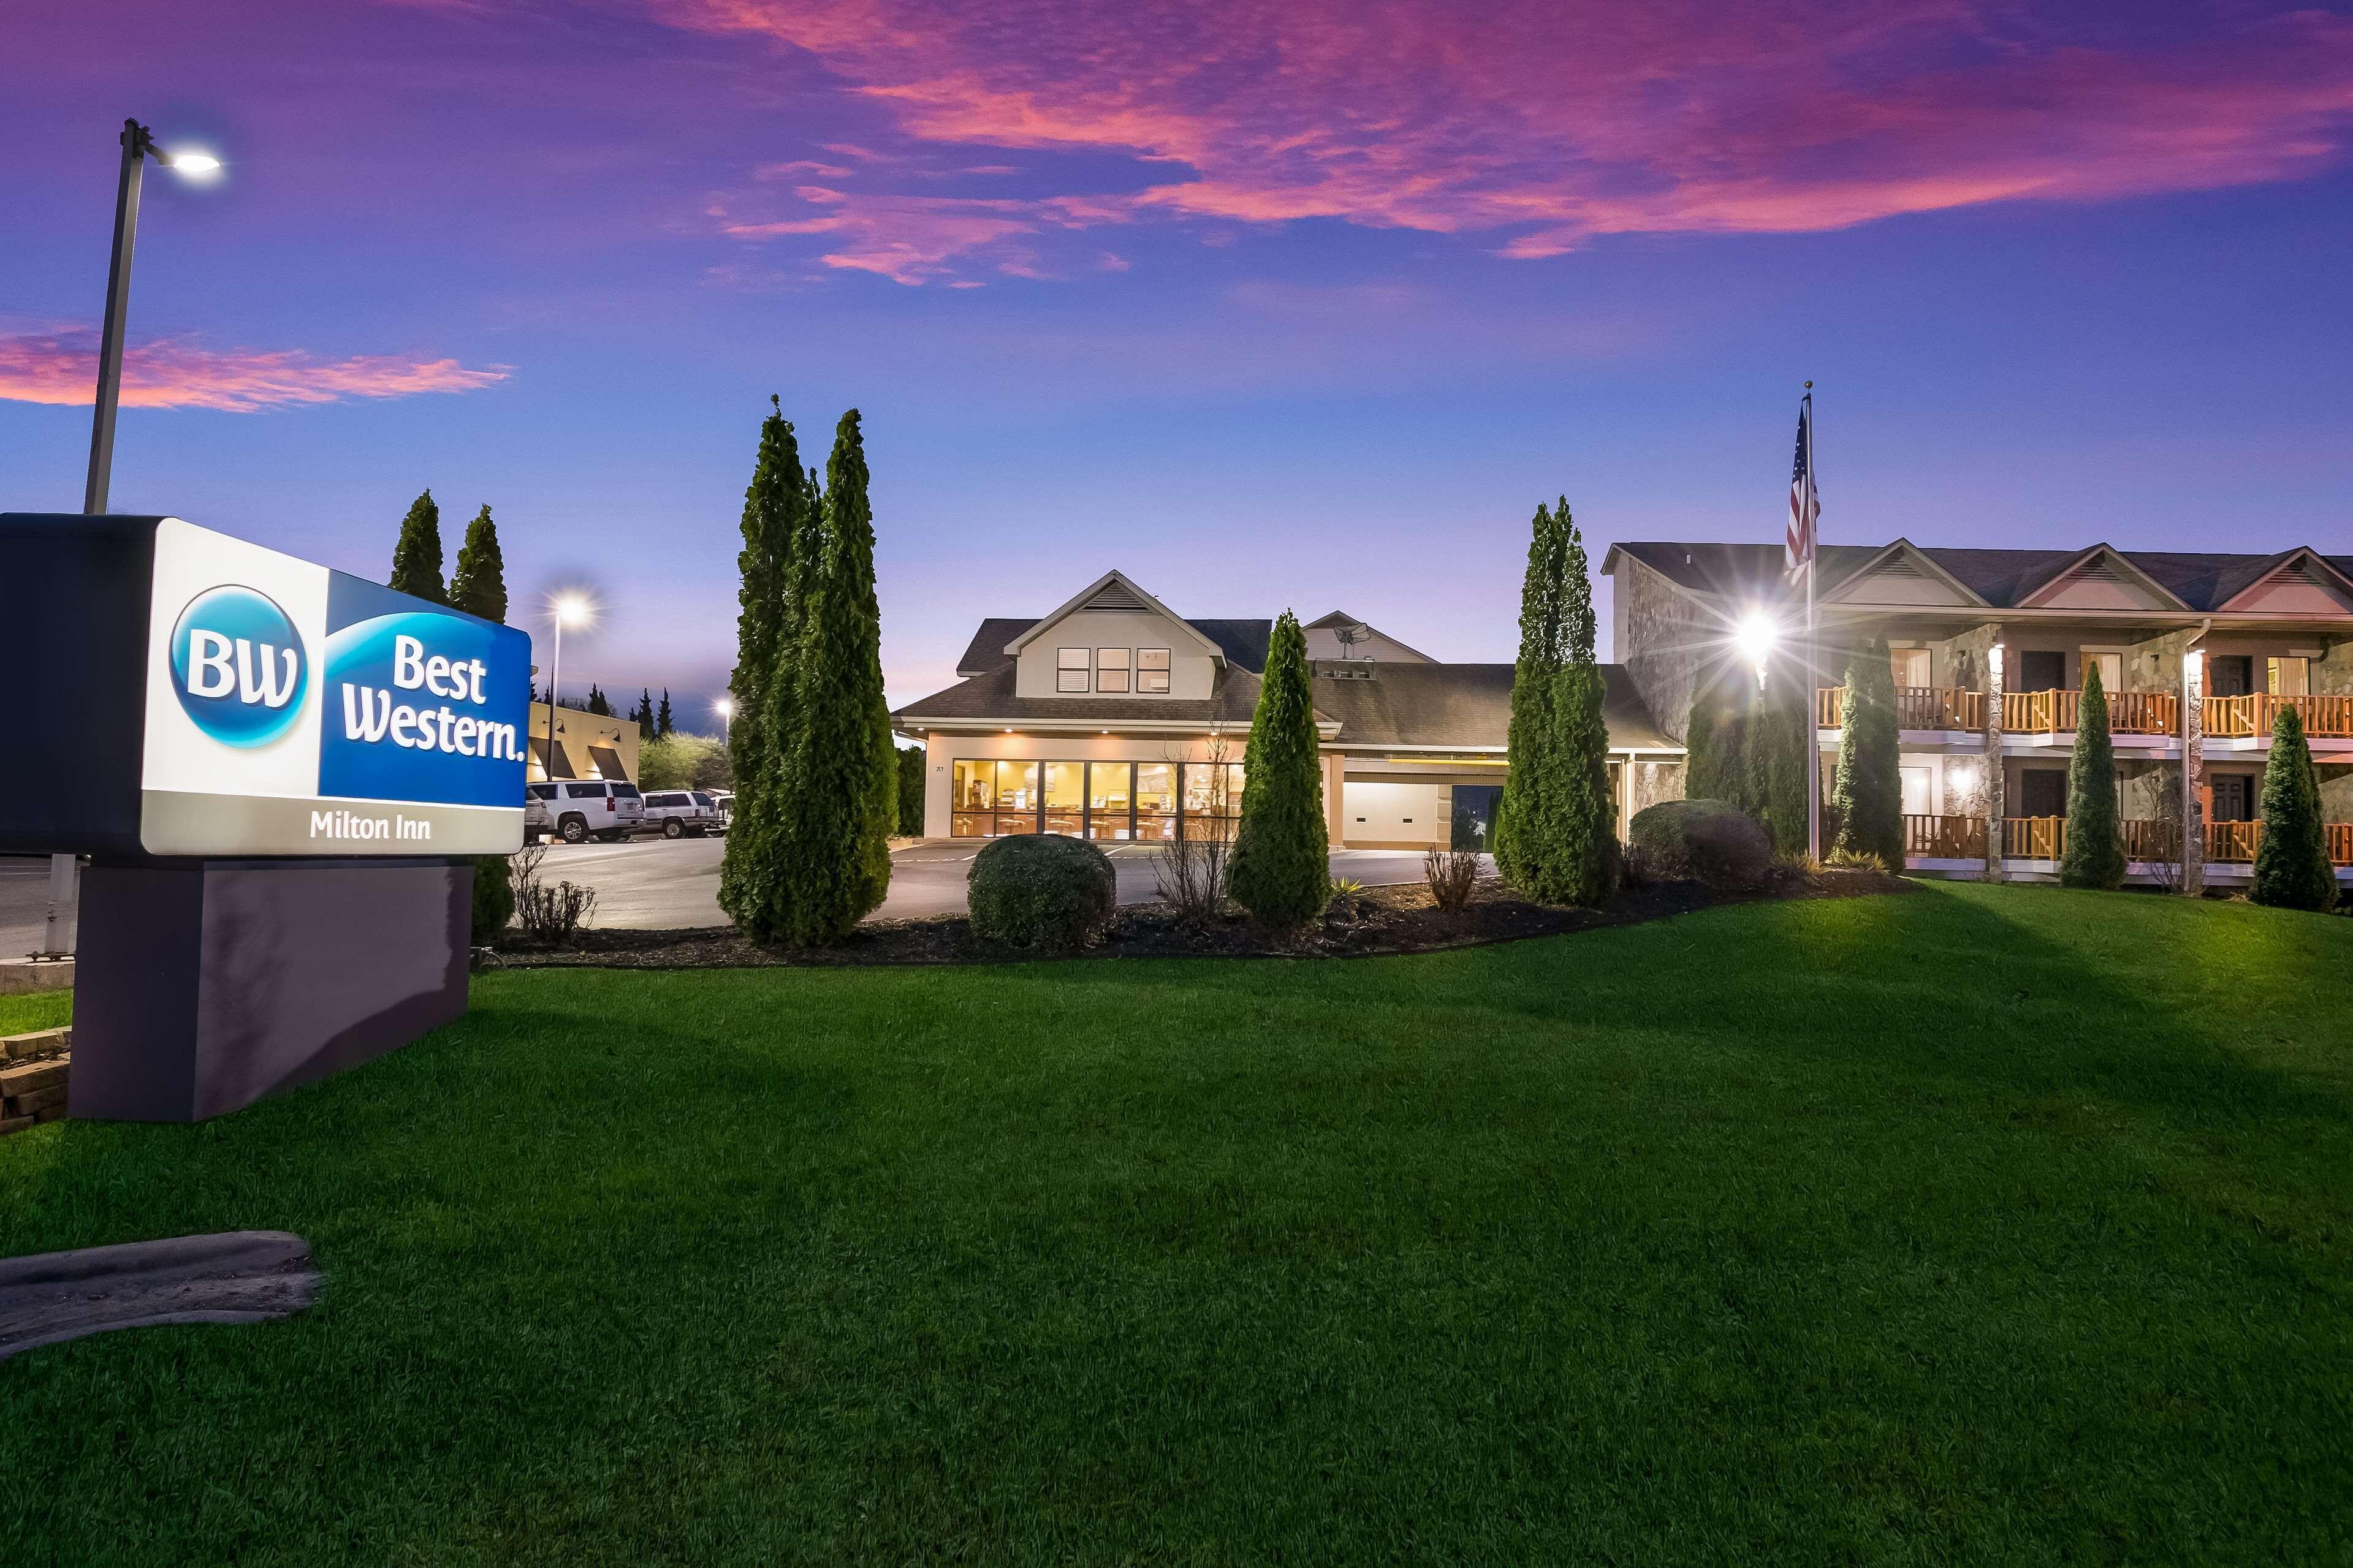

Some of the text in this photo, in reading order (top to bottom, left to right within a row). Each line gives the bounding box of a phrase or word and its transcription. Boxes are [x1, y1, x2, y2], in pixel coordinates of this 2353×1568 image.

[187, 629, 297, 708] BW
[393, 635, 487, 705] Best
[310, 810, 431, 839] Milton Inn
